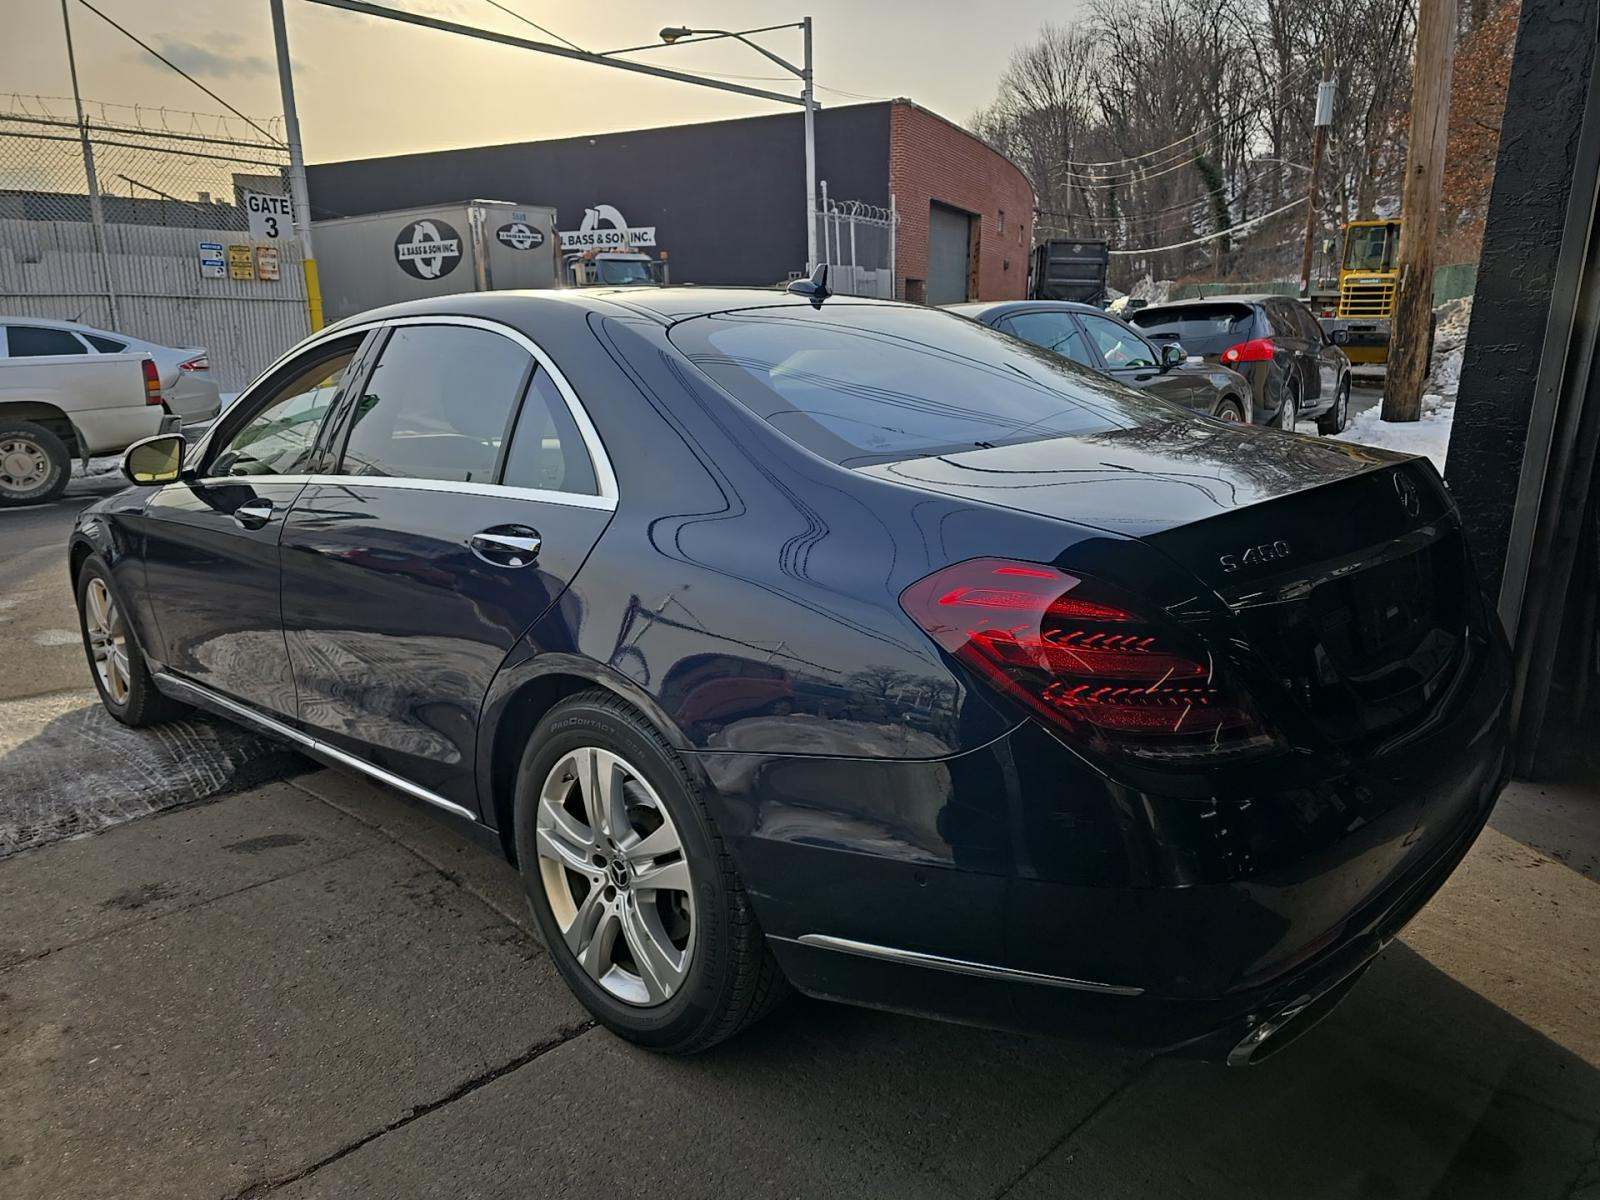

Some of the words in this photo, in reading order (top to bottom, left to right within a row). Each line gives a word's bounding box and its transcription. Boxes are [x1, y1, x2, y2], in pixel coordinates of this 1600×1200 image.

[249, 196, 289, 214] GATE
[265, 217, 279, 238] 3
[568, 234, 594, 246] BASS
[596, 234, 604, 244] &
[630, 231, 652, 243] INC.
[407, 246, 422, 255] BASS
[428, 245, 441, 254] SON
[1220, 554, 1237, 573] S
